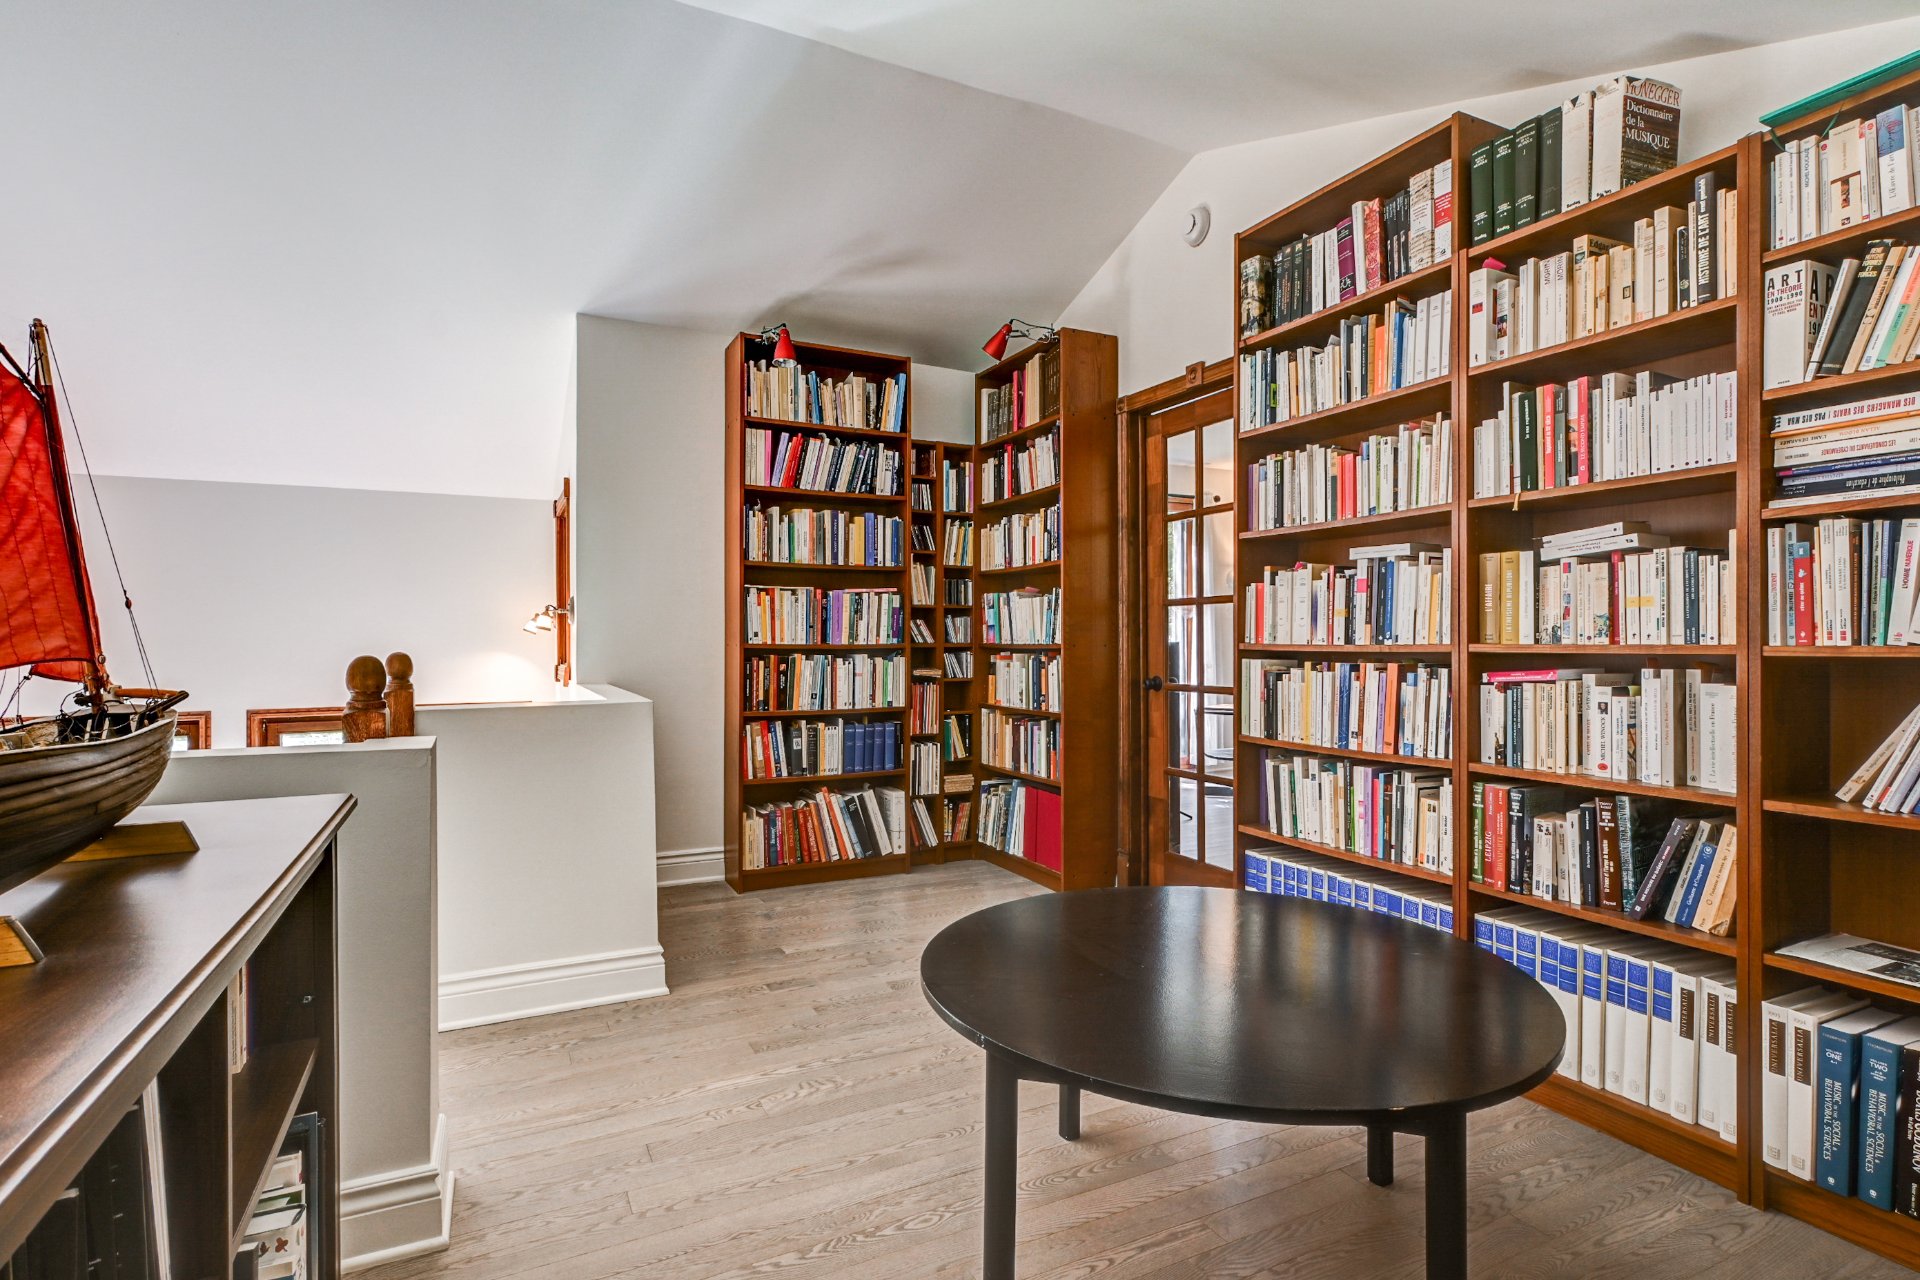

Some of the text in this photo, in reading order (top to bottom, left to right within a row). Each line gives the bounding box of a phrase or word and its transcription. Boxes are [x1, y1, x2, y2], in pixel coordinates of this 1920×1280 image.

[1627, 98, 1673, 122] Dictionnaire
[1626, 113, 1644, 128] de la
[1626, 128, 1670, 149] MUSIQUE
[1697, 213, 1710, 287] HISTOIRE DE L'ART
[1543, 259, 1551, 286] MORIN
[1556, 255, 1564, 281] MORIN
[1767, 269, 1803, 292] ART
[1767, 290, 1774, 299] EN
[1767, 289, 1803, 305] 1900-1990
[1809, 302, 1818, 319] EN
[1853, 405, 1865, 417] DES
[1866, 400, 1902, 414] MANAGERS
[1904, 396, 1917, 407] DES
[1787, 416, 1801, 427] MBA
[1801, 413, 1813, 425] DES
[1813, 411, 1826, 423] PAS
[1833, 407, 1851, 420] VRAIS
[1871, 477, 1878, 488] de
[1901, 568, 1910, 590] L'HOMME
[1484, 583, 1493, 612] L'AFFAIRE
[1708, 702, 1716, 720] France
[1484, 831, 1493, 862] LEIPZIG
[1825, 1051, 1843, 1063] ONE
[1869, 1060, 1888, 1072] TWO
[1833, 1080, 1842, 1105] MUSIC
[1878, 1091, 1887, 1116] MUSIC
[1823, 1077, 1833, 1161] BEHAVIORAL SCIENCES
[1832, 1119, 1842, 1147] SOCIAL
[1865, 1088, 1877, 1173] BEHAVIORAL SCIENCES
[1875, 1131, 1885, 1158] SOCIAL
